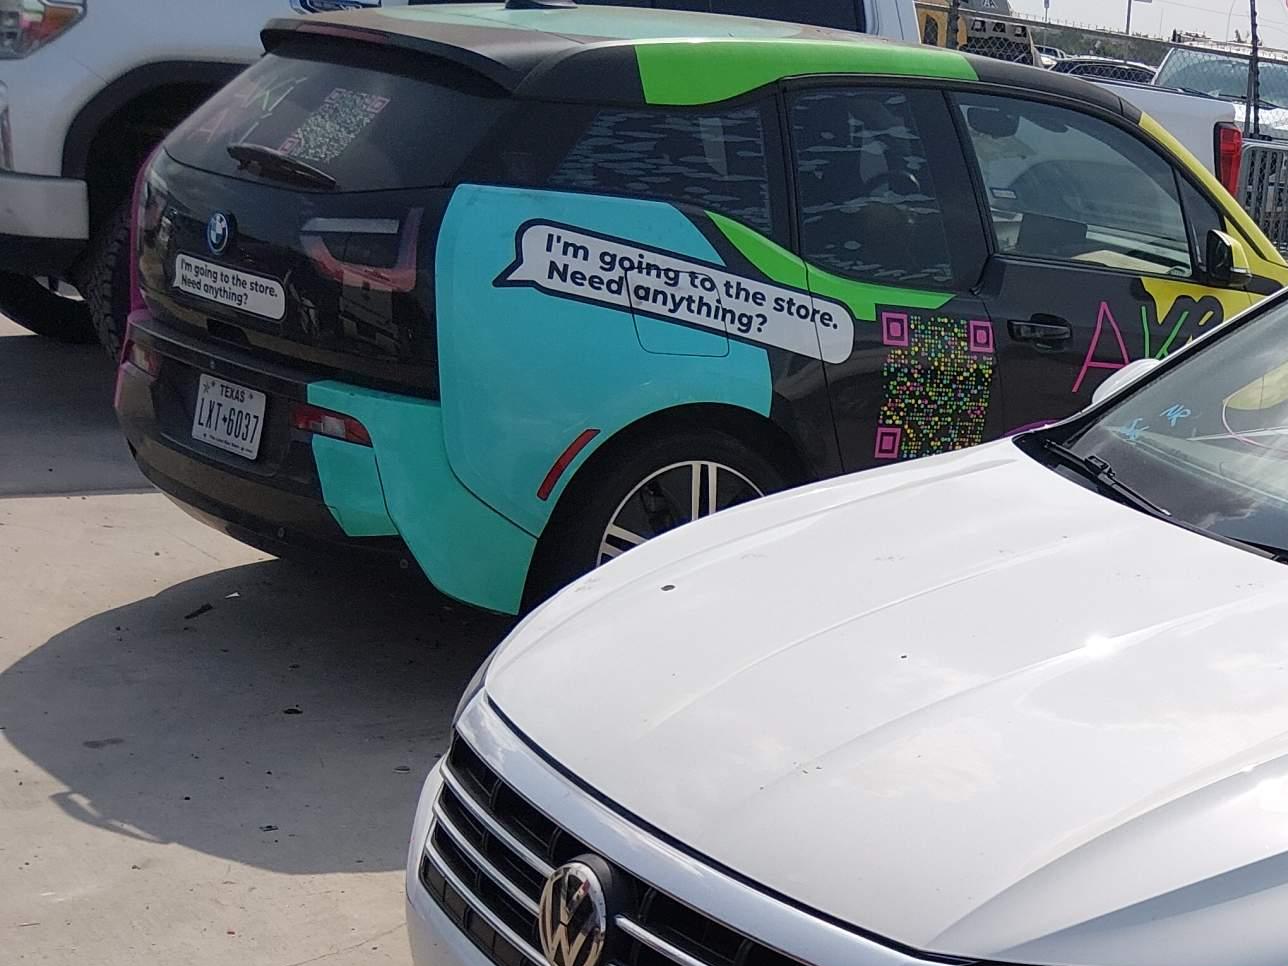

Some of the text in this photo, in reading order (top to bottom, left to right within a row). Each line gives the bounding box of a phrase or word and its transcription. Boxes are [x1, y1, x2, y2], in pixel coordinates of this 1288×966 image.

[181, 258, 278, 297] I'm going to the store.
[181, 274, 248, 306] Need anything?
[546, 233, 838, 330] I'm going to the store.
[547, 260, 768, 333] Need anything?
[220, 384, 246, 402] TEXAS
